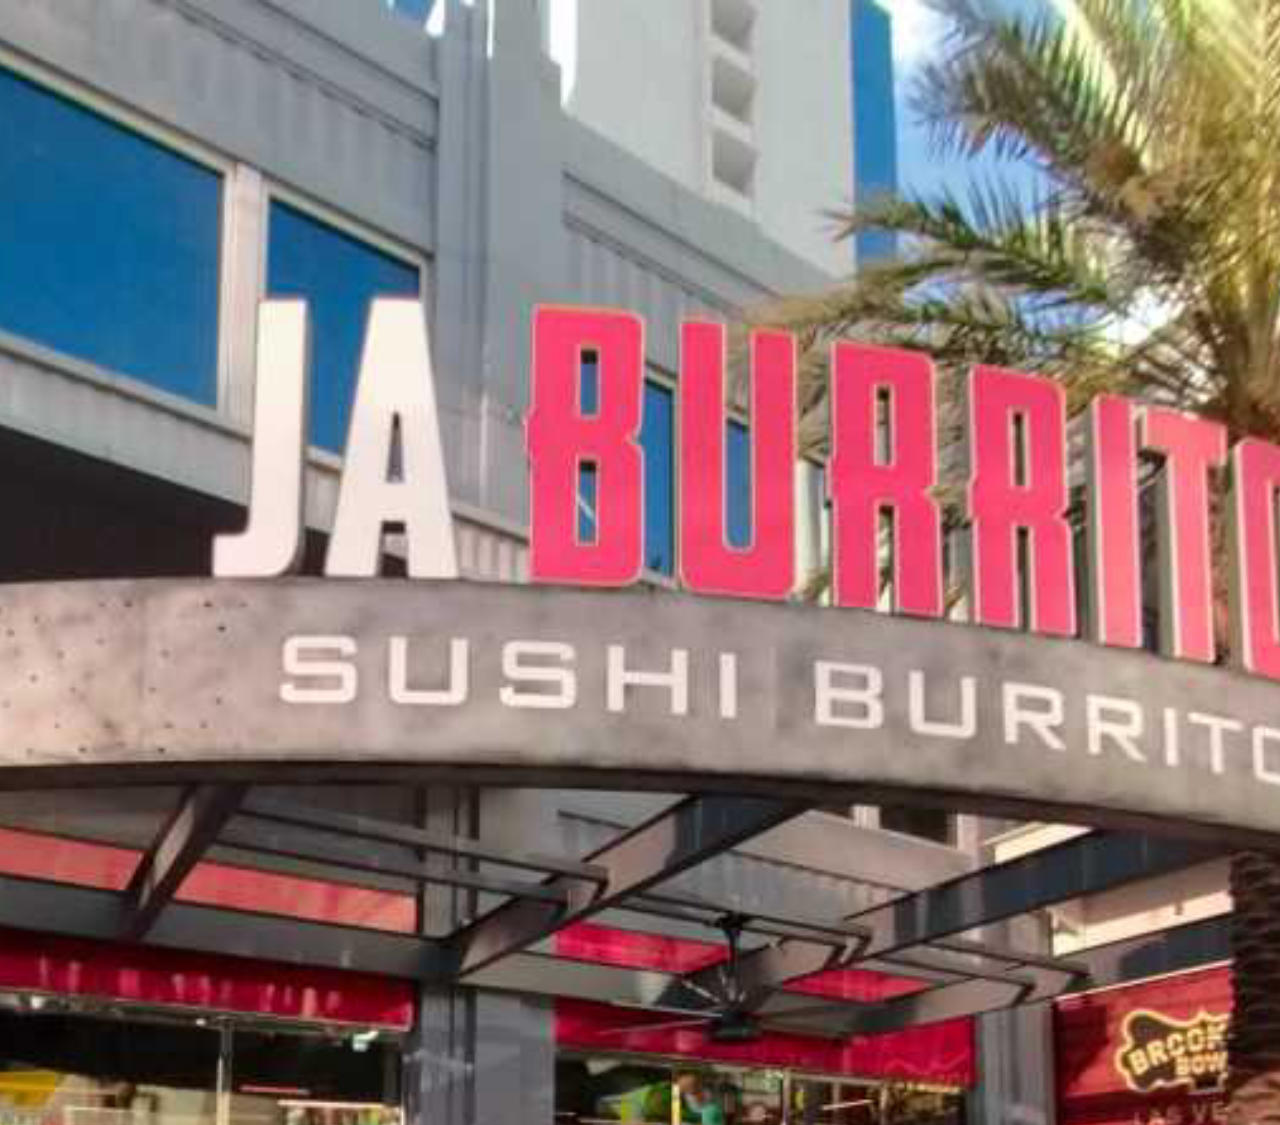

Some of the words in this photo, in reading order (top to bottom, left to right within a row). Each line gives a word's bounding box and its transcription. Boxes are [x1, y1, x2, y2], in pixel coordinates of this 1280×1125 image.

[211, 297, 458, 581] JA
[279, 634, 738, 720] SUSHI
[1128, 1022, 1227, 1076] BROOK
[1175, 1050, 1228, 1076] BOW
[1191, 1101, 1228, 1124] VE
